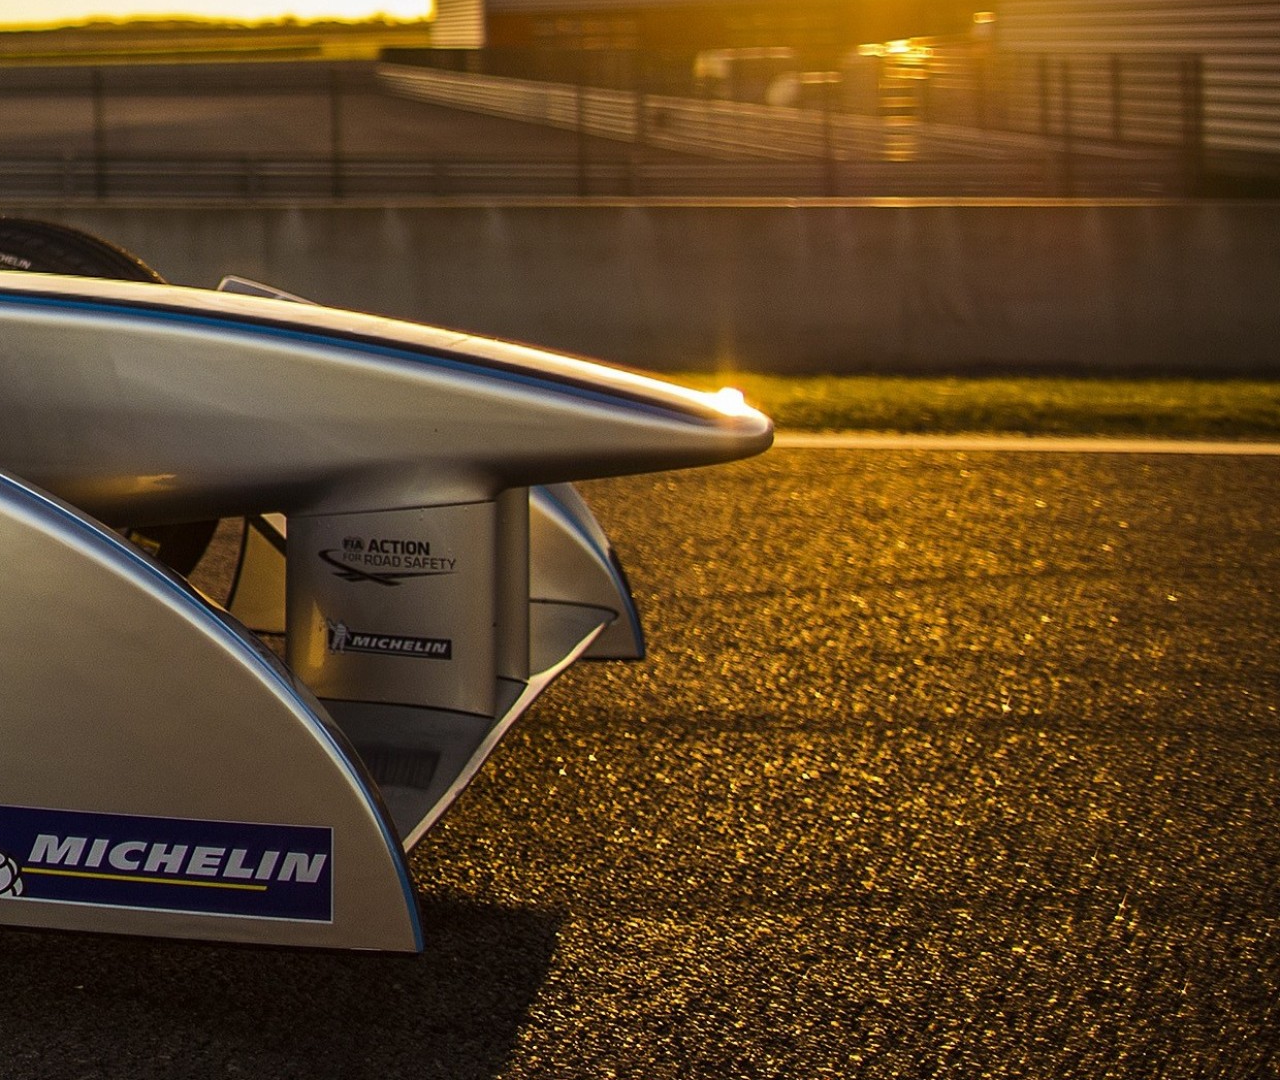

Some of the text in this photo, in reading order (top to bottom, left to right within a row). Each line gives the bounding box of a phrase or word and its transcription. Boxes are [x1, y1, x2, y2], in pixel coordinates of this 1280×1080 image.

[368, 538, 430, 556] ACTION
[343, 552, 457, 570] FOR ROAD SAFETY
[351, 636, 448, 654] MICHELIN
[27, 833, 328, 884] MICHELIN
